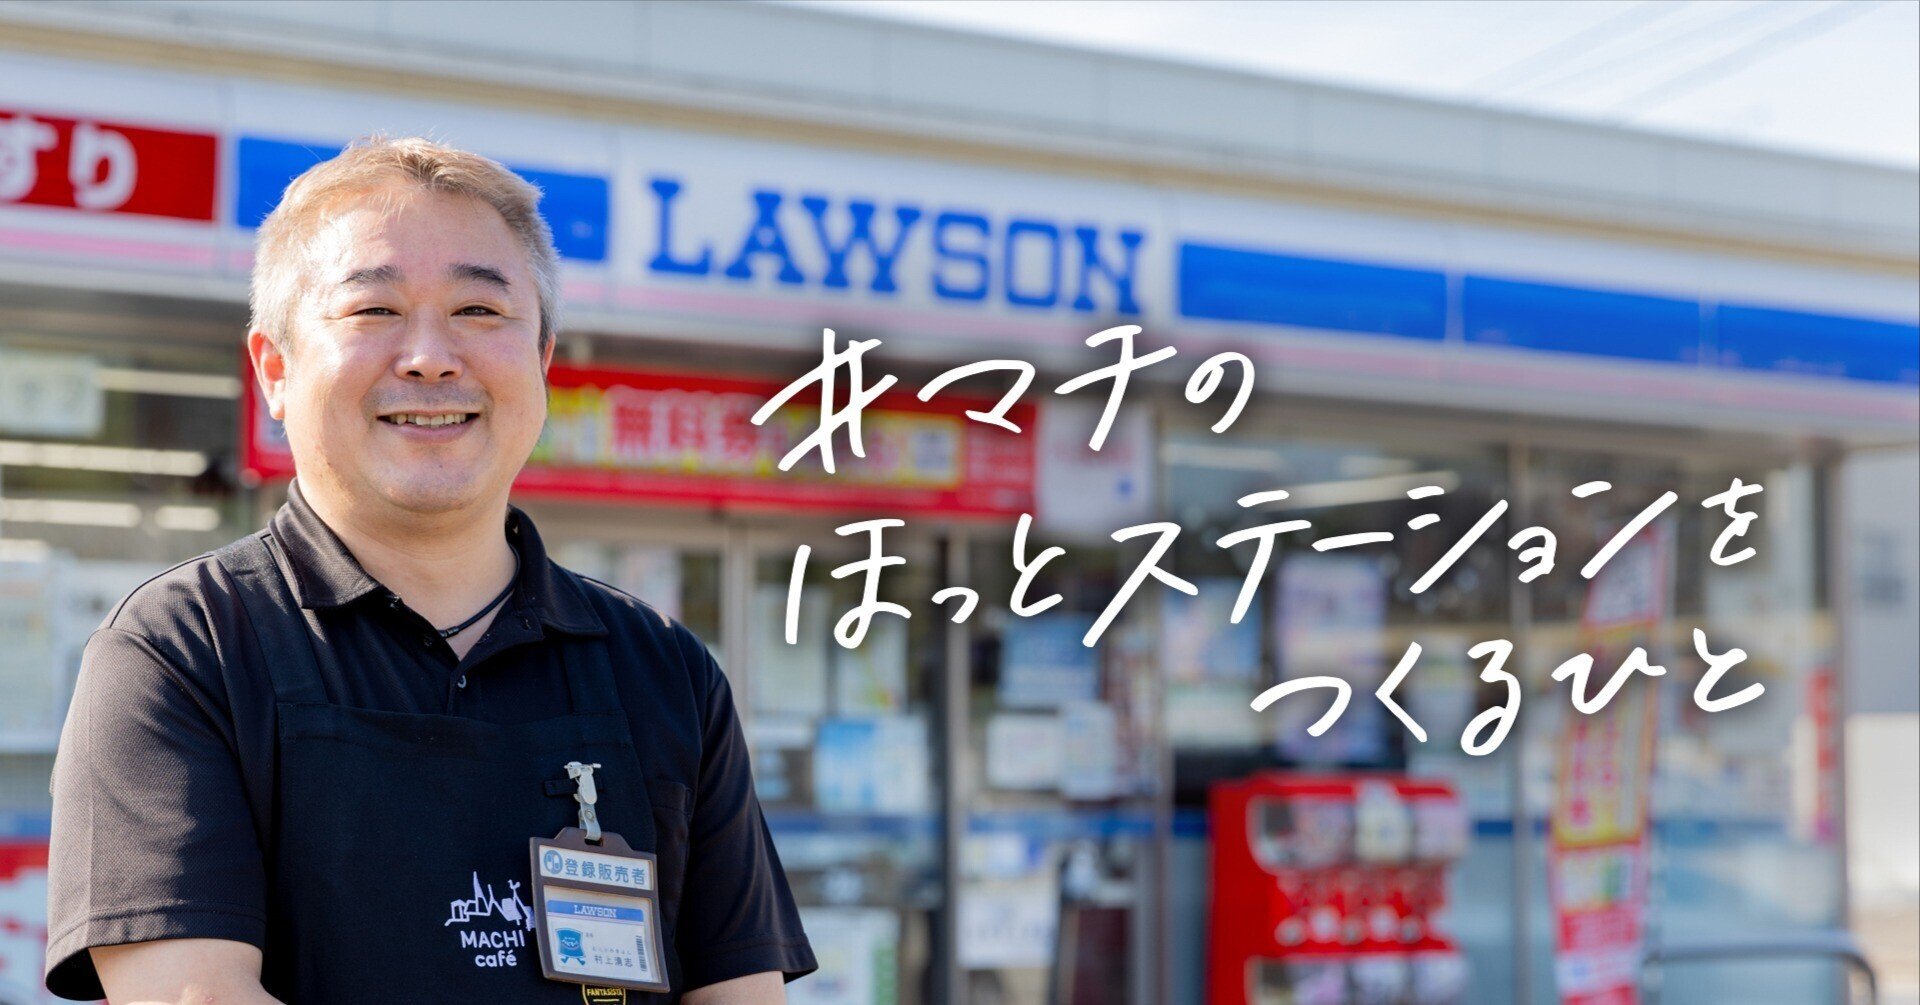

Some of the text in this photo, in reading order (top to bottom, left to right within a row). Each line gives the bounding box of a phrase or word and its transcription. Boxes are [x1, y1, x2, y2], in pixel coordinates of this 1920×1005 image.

[0, 113, 139, 211] すり
[647, 177, 1144, 316] LAWSON
[564, 858, 646, 886] 登録販売者
[573, 904, 617, 918] LAWSON
[460, 929, 526, 949] MACHI
[474, 949, 518, 968] café
